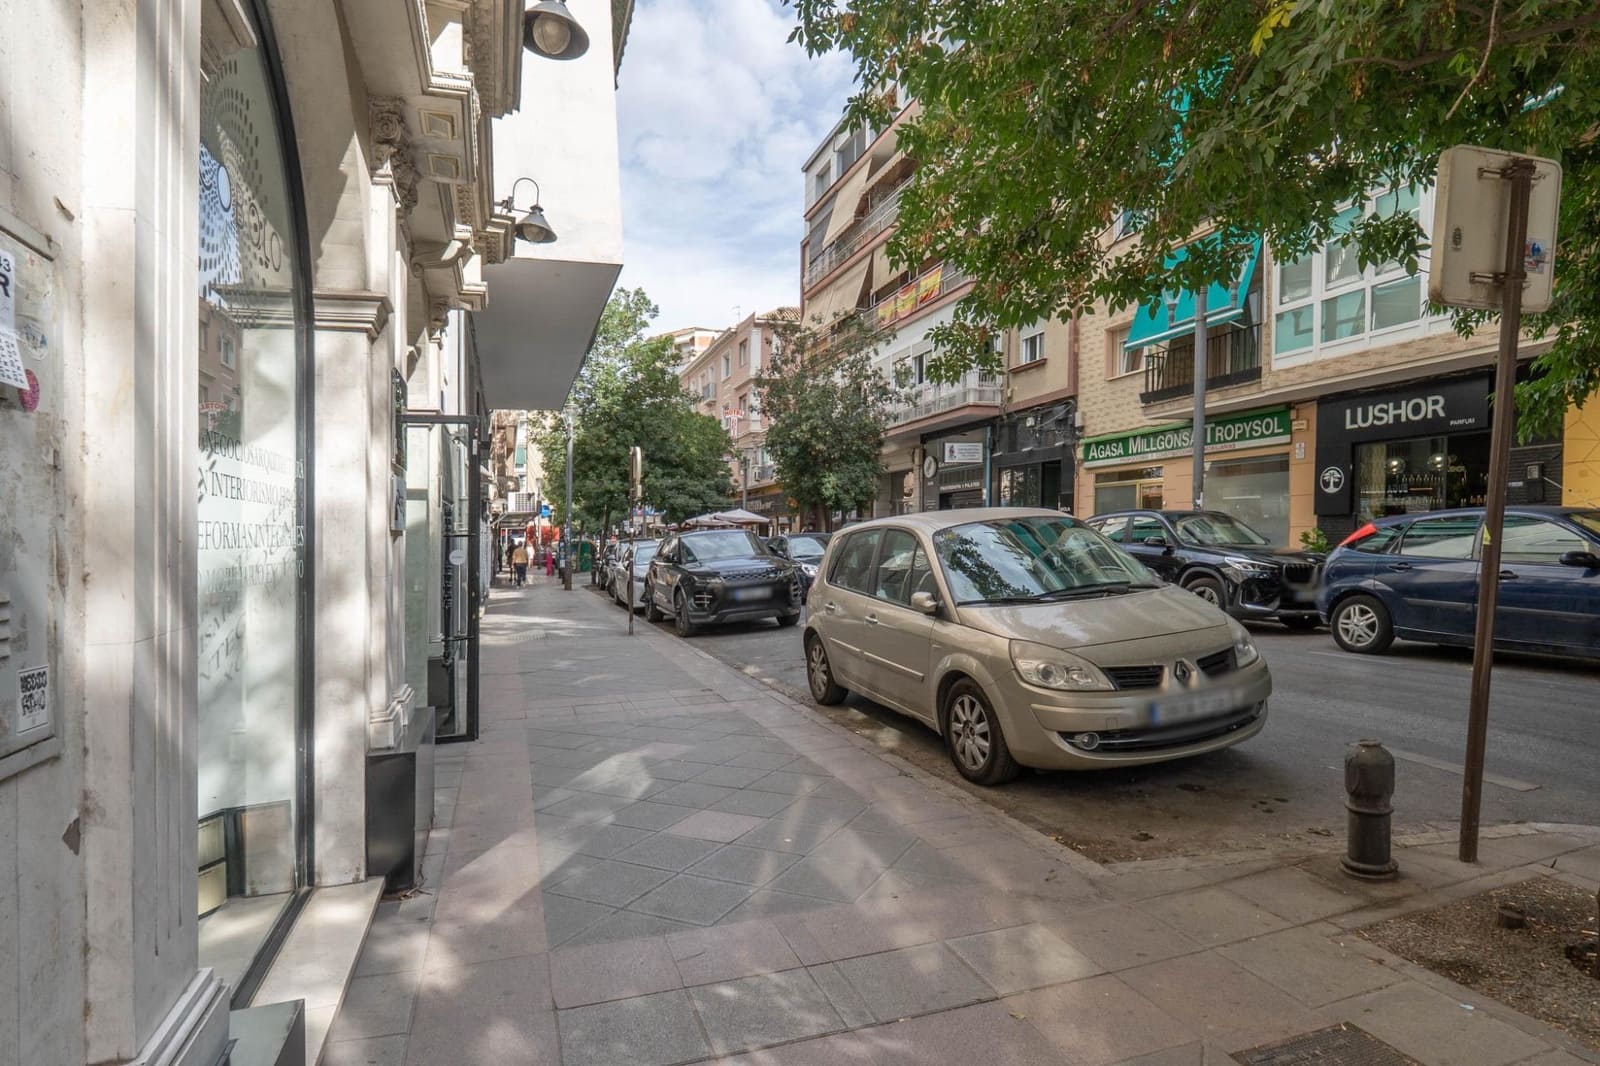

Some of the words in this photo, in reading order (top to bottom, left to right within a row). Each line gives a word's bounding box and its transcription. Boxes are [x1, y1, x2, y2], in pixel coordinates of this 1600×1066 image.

[723, 408, 743, 418] HOTEL
[1345, 395, 1445, 430] LUSHOR
[1449, 417, 1476, 426] PARFUM
[1204, 416, 1285, 444] TROPYSOL
